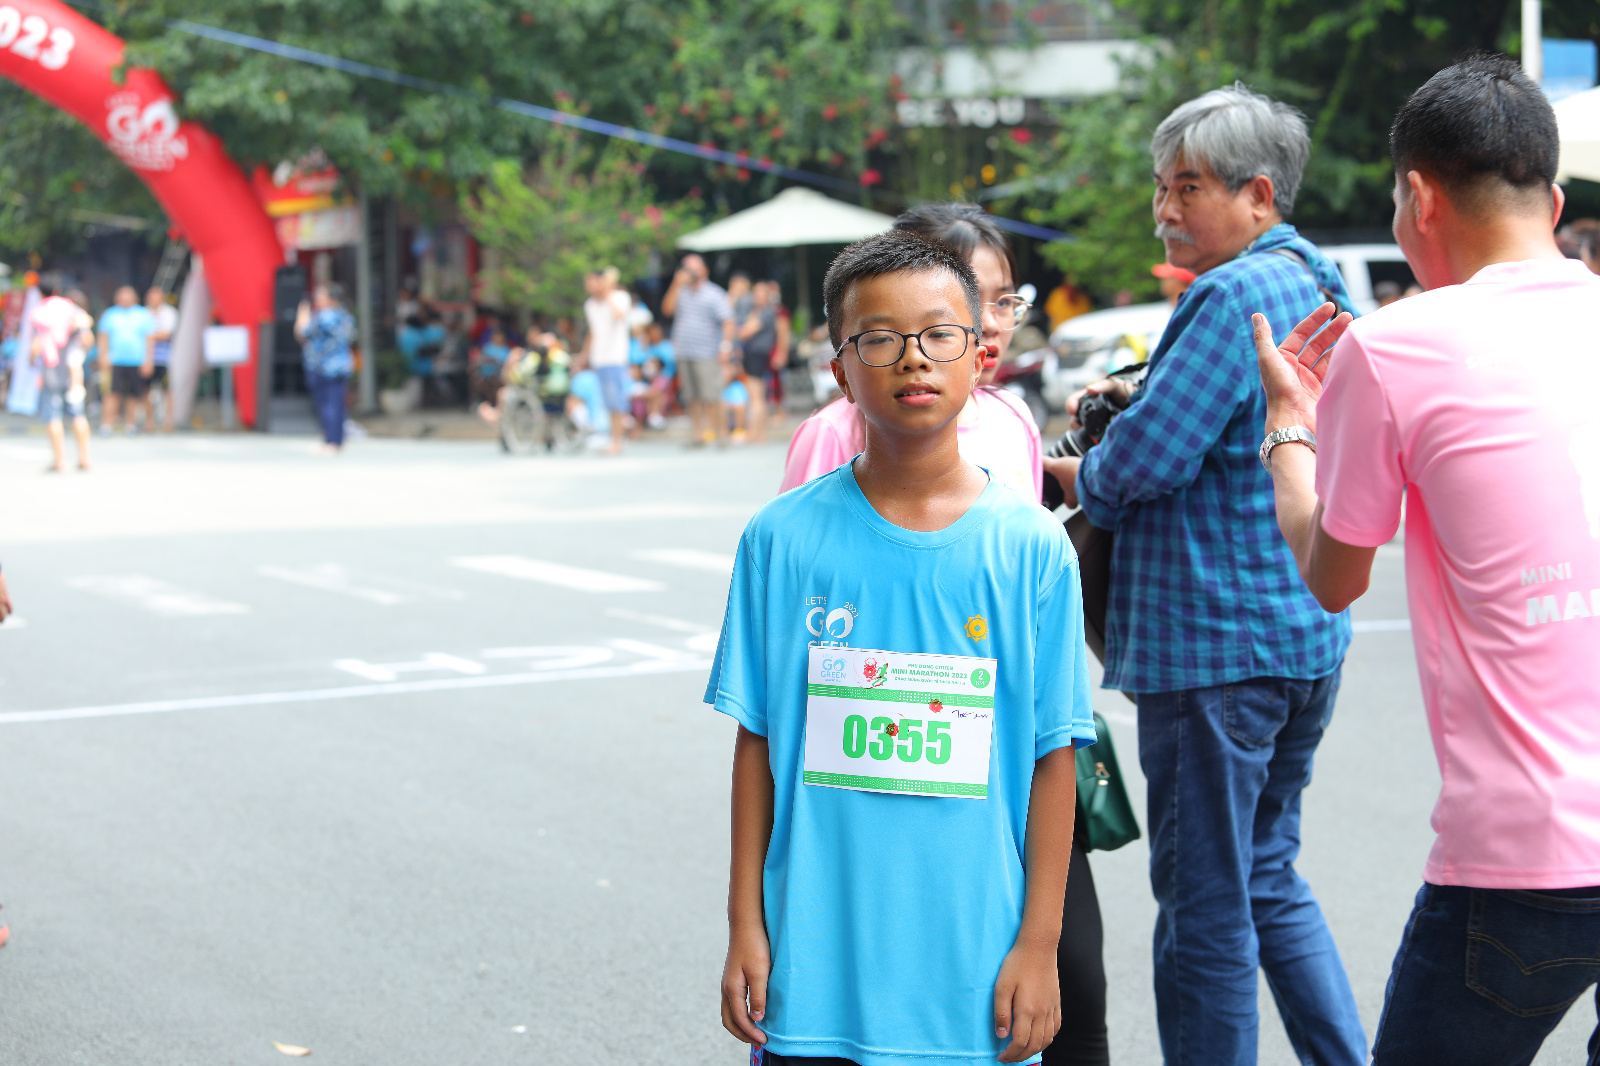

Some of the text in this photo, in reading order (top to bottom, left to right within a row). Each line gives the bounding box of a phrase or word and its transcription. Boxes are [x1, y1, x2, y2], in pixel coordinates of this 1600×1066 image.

[951, 97, 1026, 129] YOU
[1521, 562, 1572, 586] MINI
[806, 606, 854, 639] GO
[822, 658, 845, 672] GO
[909, 669, 950, 678] MARATHON
[820, 671, 847, 679] GREEN
[978, 670, 985, 681] 2
[843, 714, 951, 765] 0355
